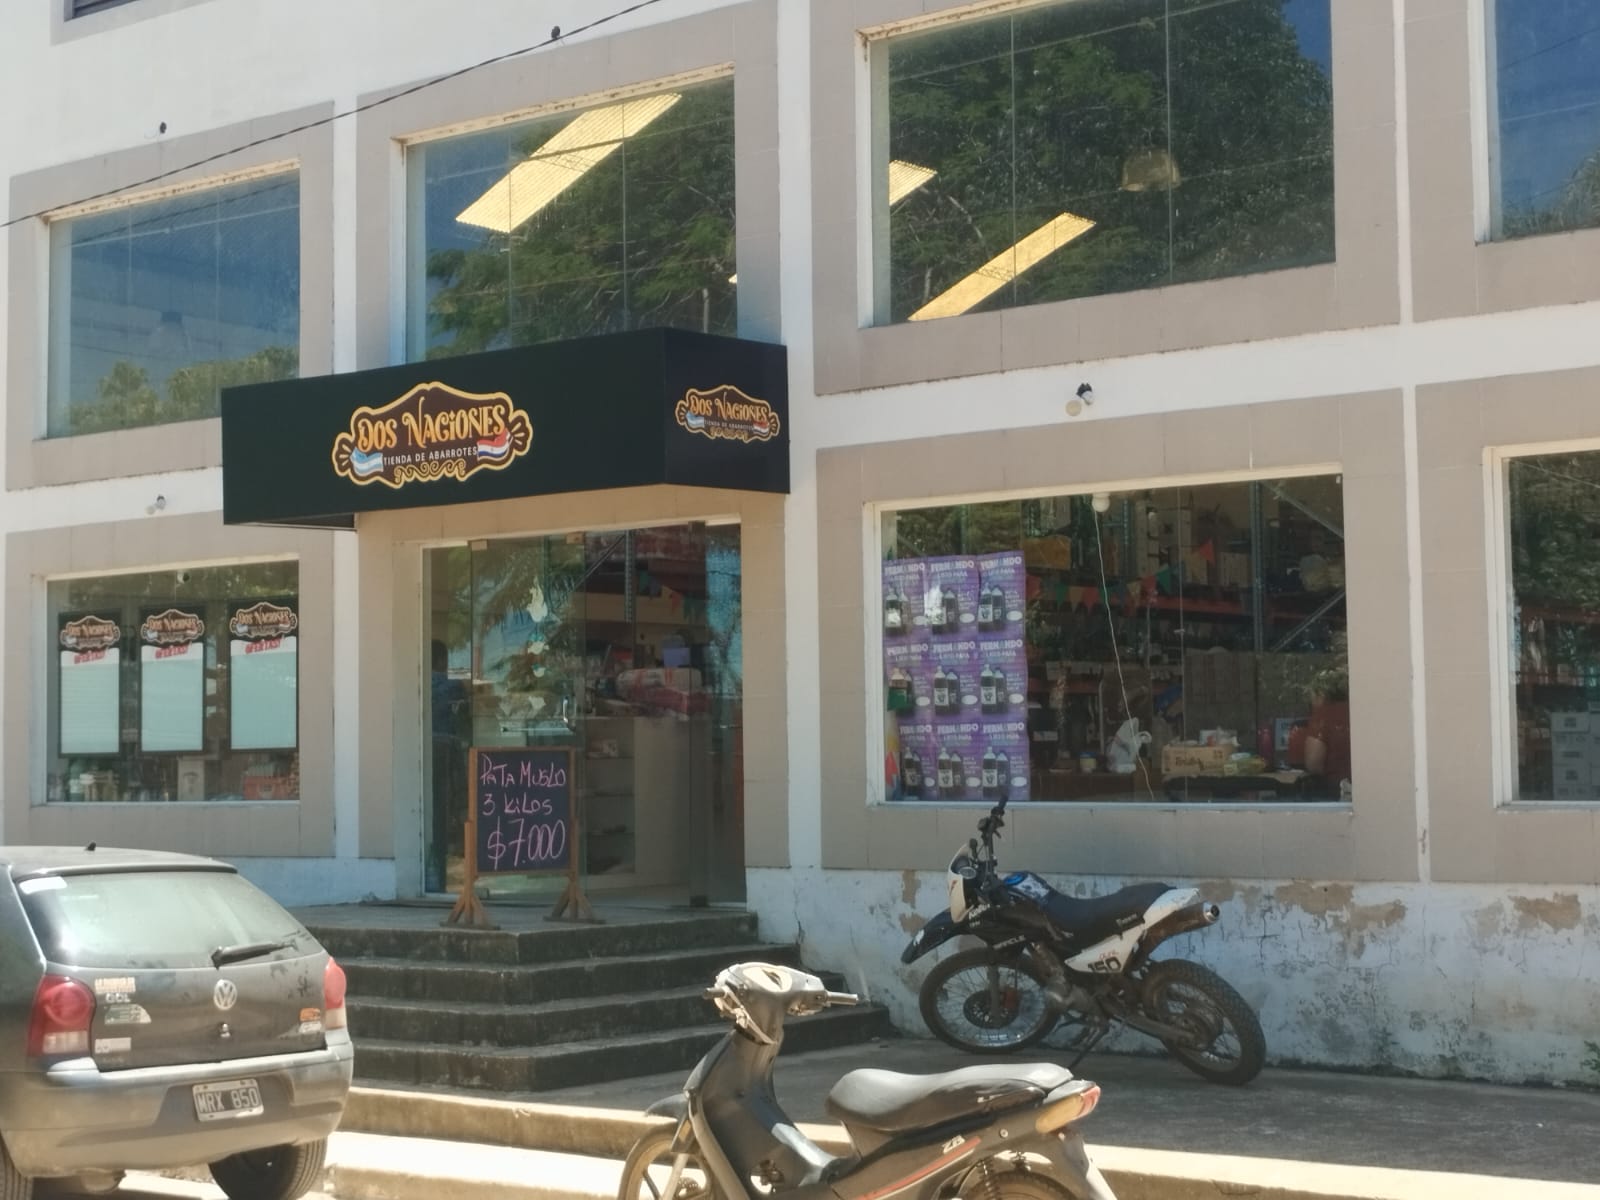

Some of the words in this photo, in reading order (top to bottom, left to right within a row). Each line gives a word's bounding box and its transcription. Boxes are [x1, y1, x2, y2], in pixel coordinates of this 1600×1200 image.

[690, 395, 712, 416] DOS
[357, 418, 397, 451] DOS
[383, 455, 412, 466] TIENDA
[415, 453, 426, 463] DE
[429, 446, 478, 461] ABARROTES
[482, 793, 496, 816] 3
[230, 1087, 260, 1110] 850
